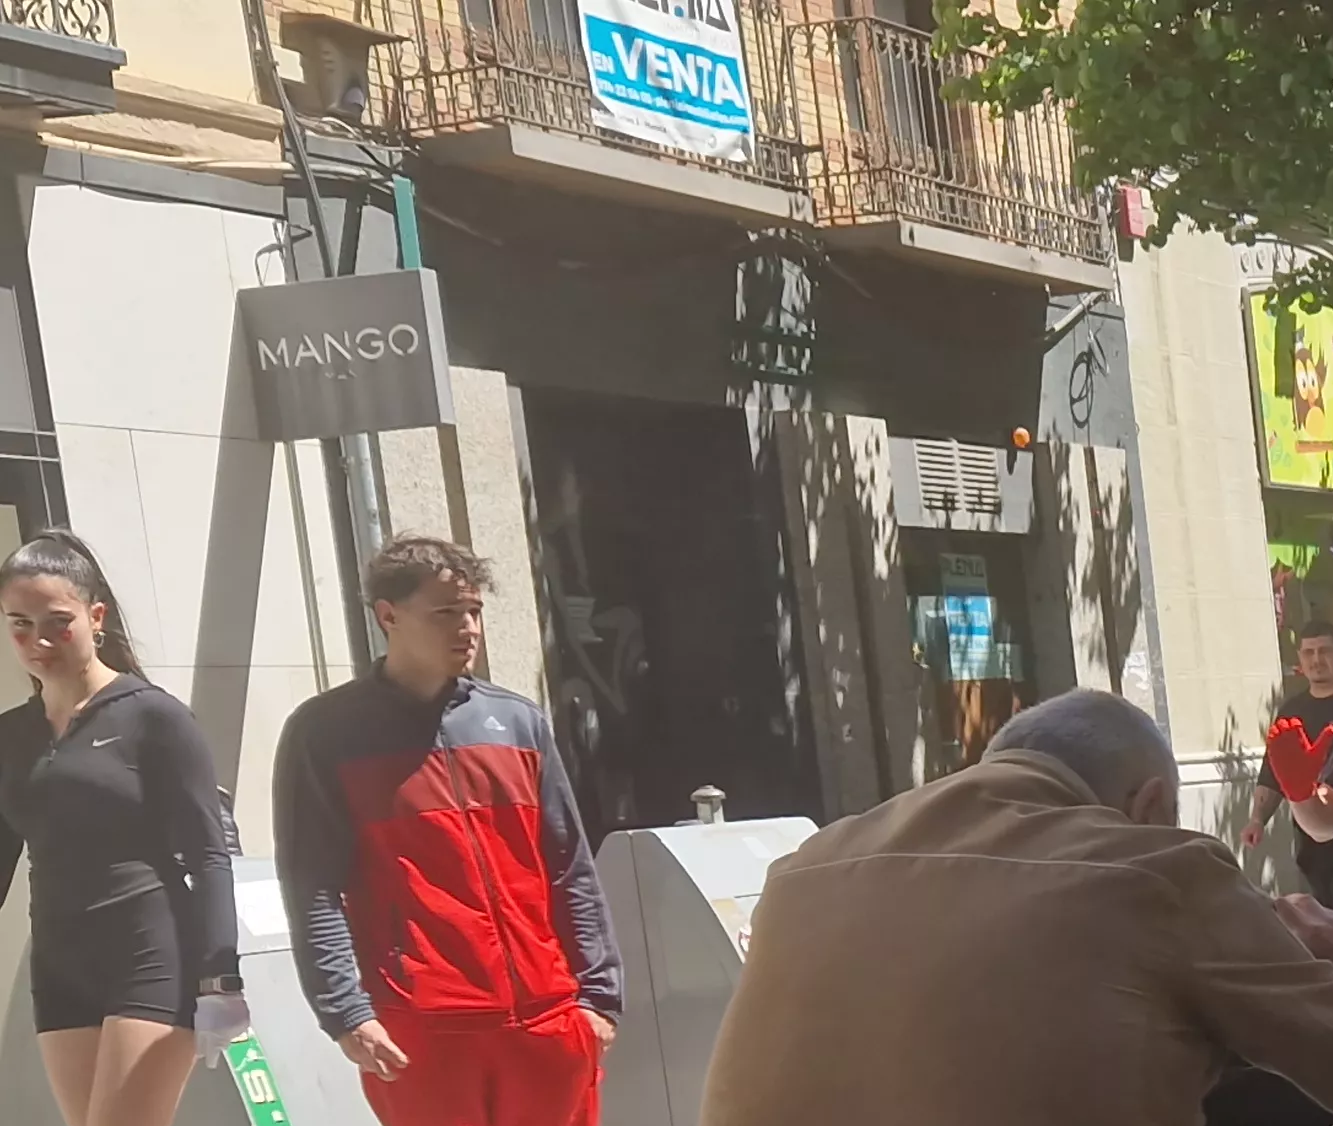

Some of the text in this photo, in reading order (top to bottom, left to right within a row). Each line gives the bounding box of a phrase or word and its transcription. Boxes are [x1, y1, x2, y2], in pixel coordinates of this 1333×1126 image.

[592, 50, 616, 75] EN
[610, 31, 746, 110] VENTA
[257, 323, 419, 371] MANGO
